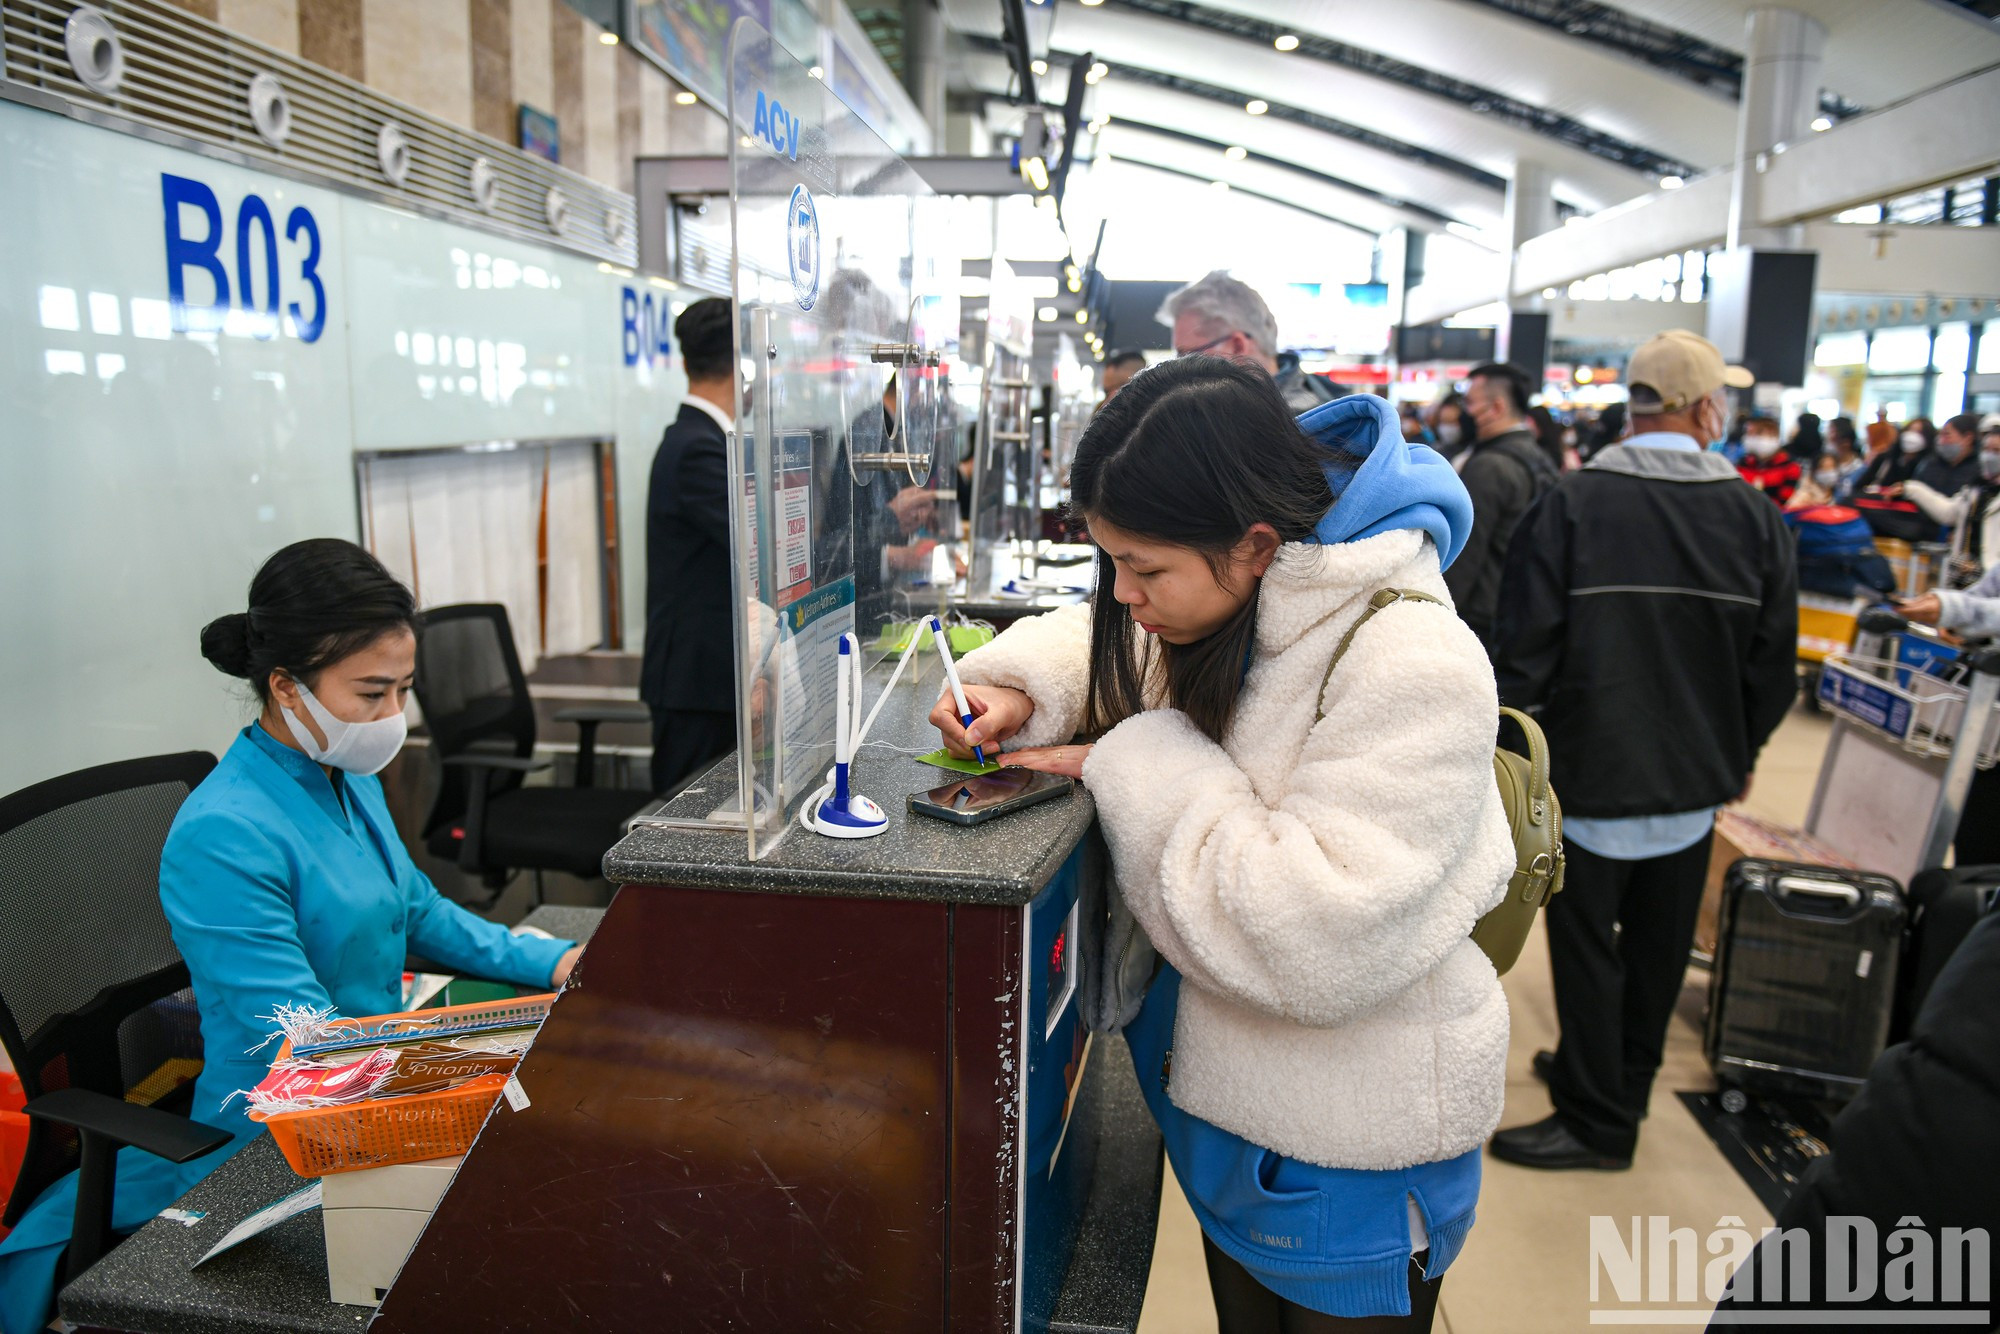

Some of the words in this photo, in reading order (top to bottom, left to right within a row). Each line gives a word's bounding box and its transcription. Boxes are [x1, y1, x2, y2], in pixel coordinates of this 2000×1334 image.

[754, 89, 799, 161] ACV
[161, 172, 326, 344] B03
[622, 286, 672, 370] B04
[411, 1062, 497, 1076] Priority
